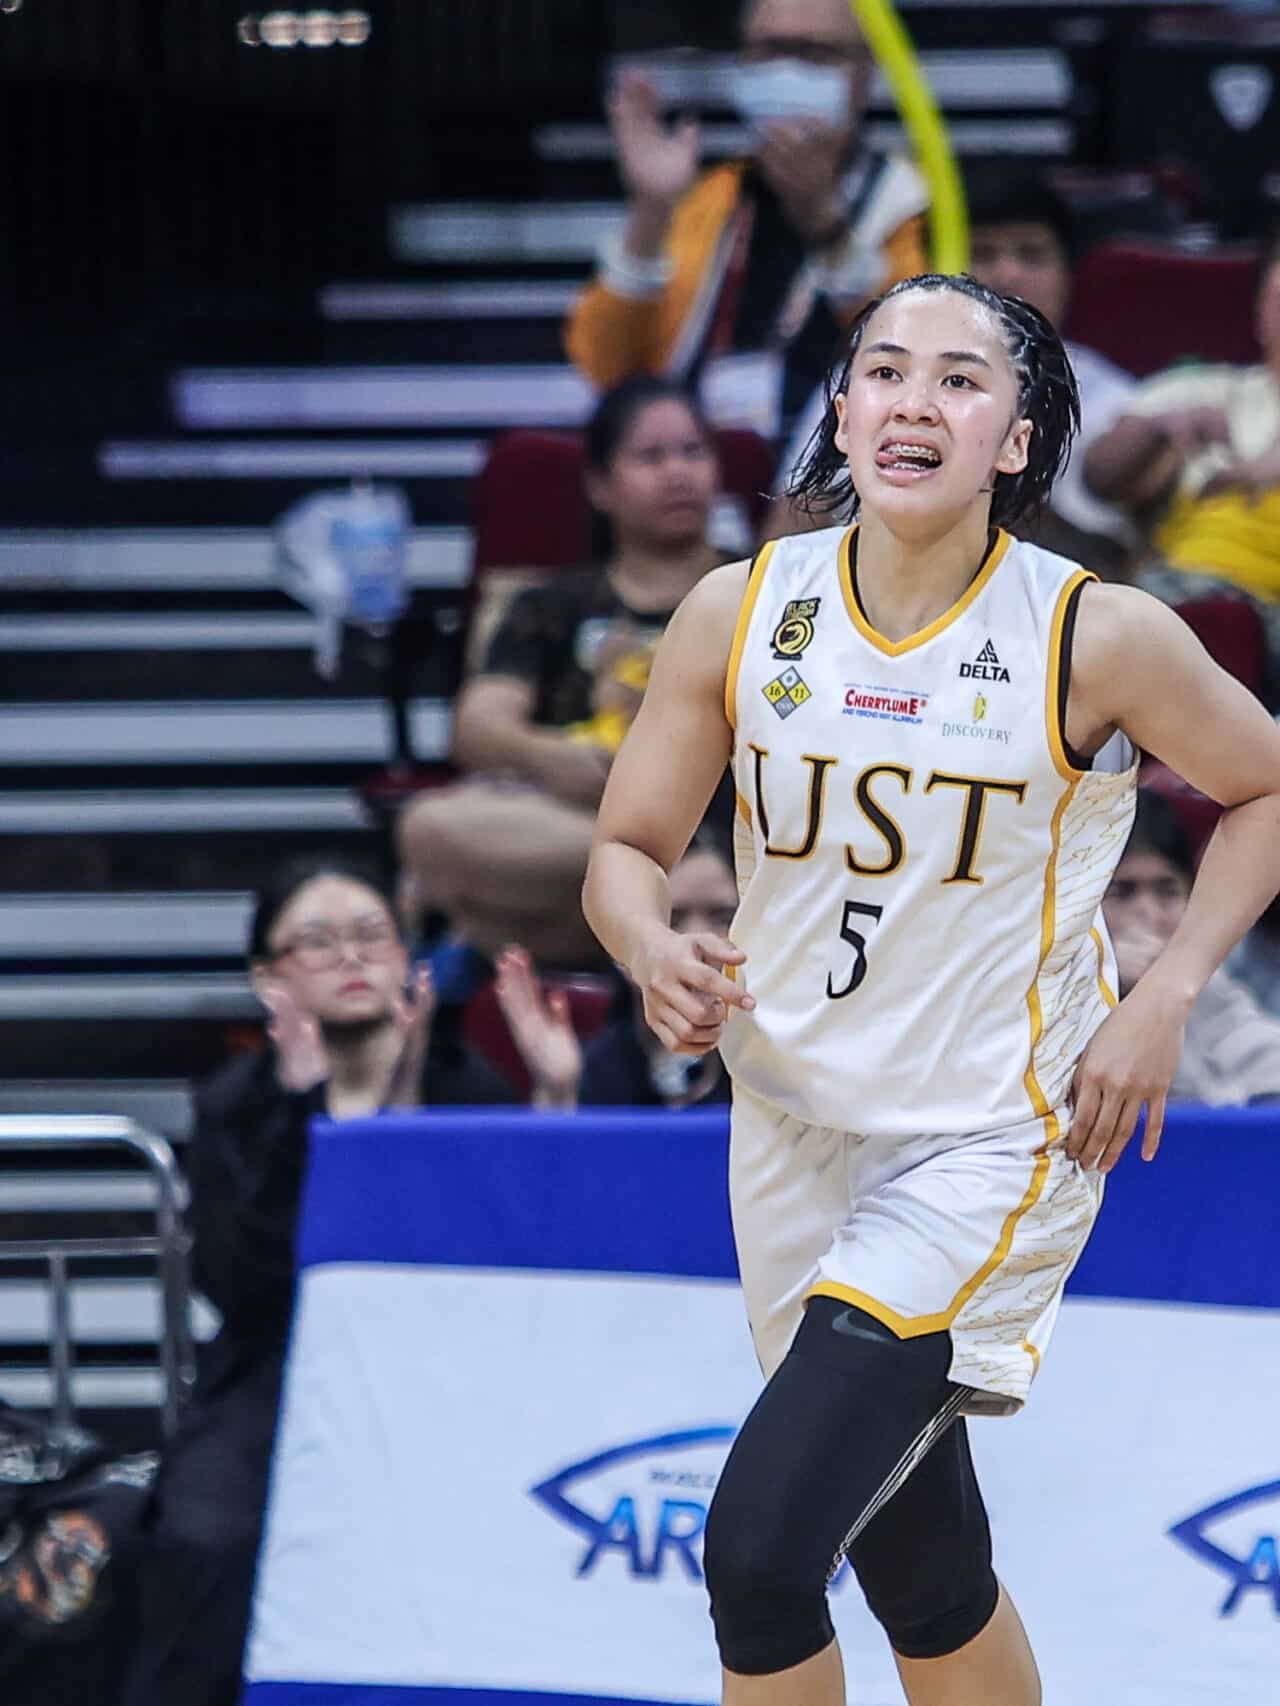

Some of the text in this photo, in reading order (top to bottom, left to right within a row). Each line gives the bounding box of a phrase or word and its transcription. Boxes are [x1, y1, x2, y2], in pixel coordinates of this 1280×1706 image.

[959, 662, 1011, 684] DELTA
[942, 722, 1012, 745] DISCOVERY
[747, 743, 1029, 885] UST
[826, 900, 883, 1000] 5
